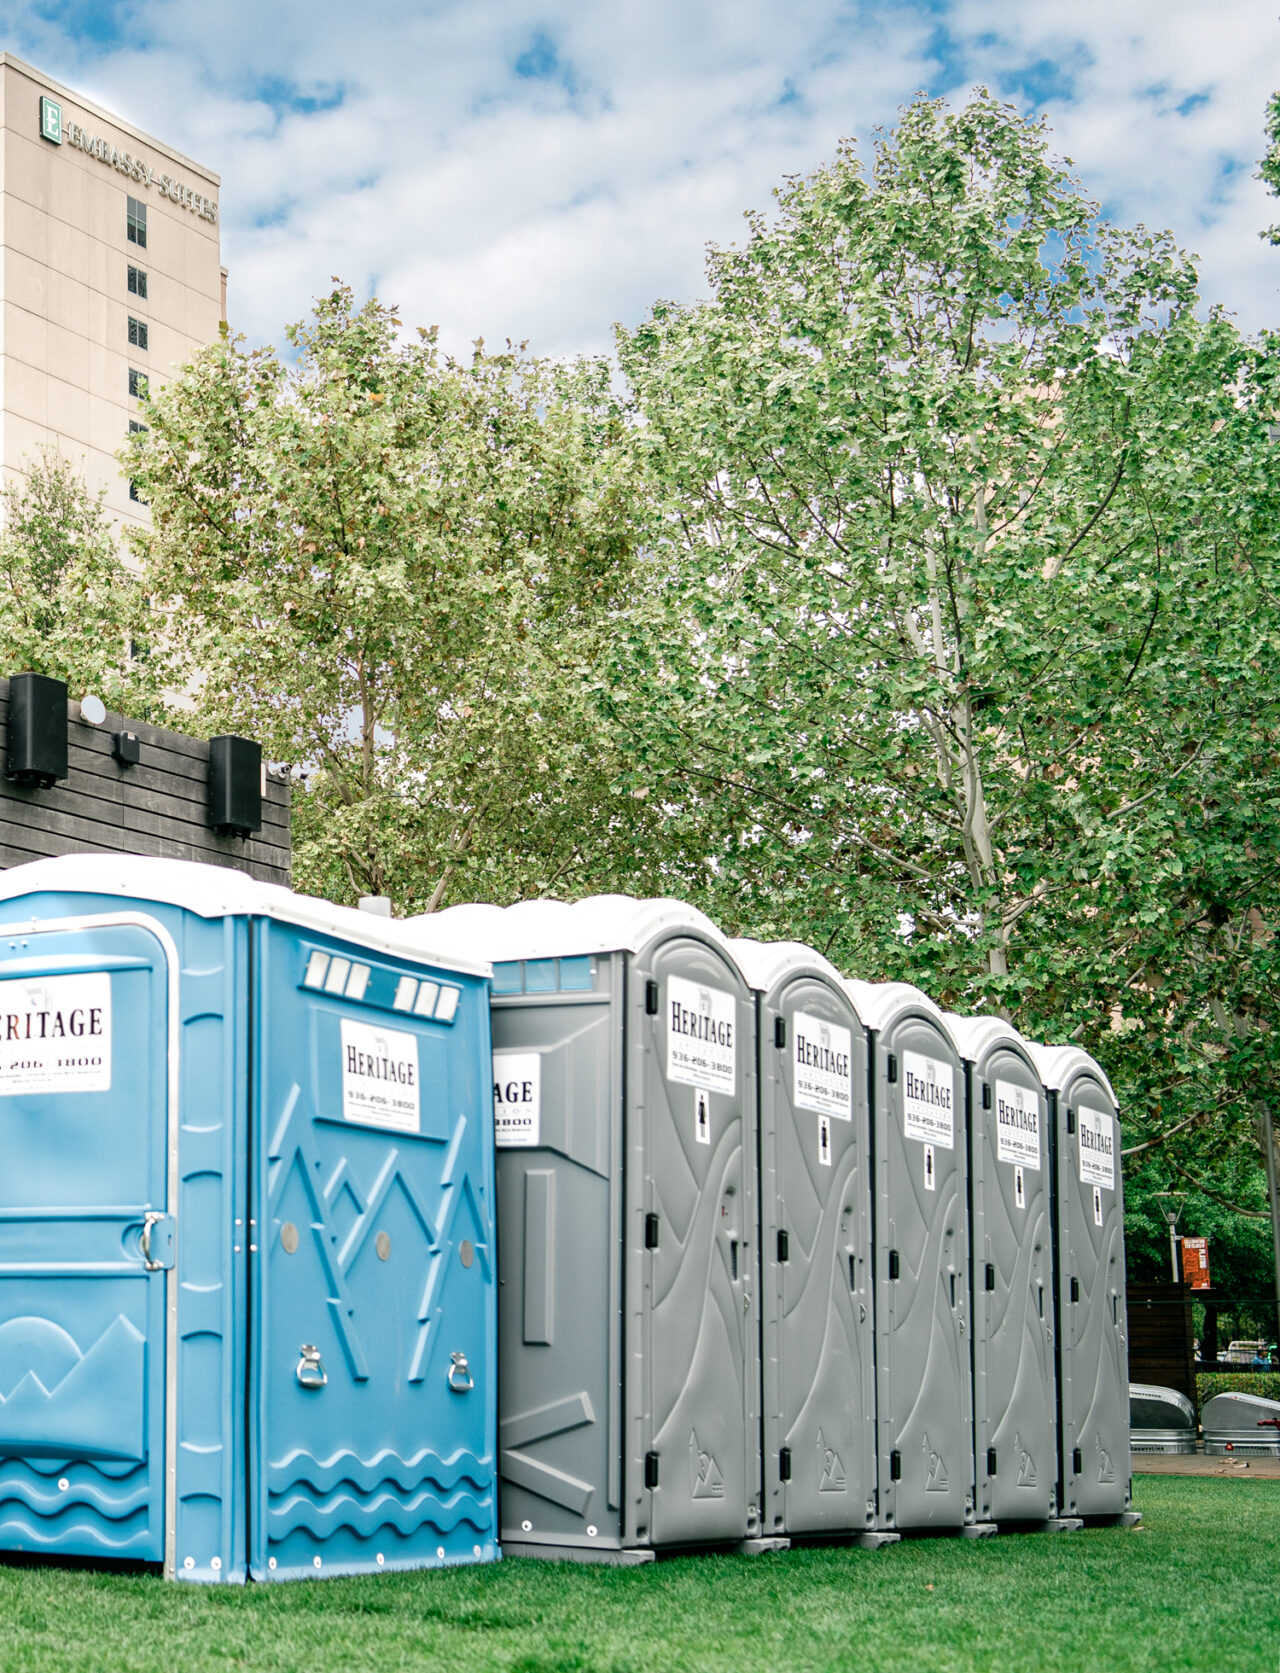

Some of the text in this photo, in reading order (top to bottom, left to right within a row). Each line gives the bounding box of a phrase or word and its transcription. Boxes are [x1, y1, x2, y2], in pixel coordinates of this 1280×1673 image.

[46, 104, 59, 136] E
[68, 121, 218, 224] EMBASSY SUITES
[672, 1001, 733, 1048] HERITAGE
[347, 1045, 415, 1086] HERITAGE
[796, 1034, 849, 1078] HERITAGE
[906, 1071, 952, 1109] HERITAGE
[998, 1099, 1038, 1133] HERITAGE
[1080, 1124, 1112, 1155] HERITAGE
